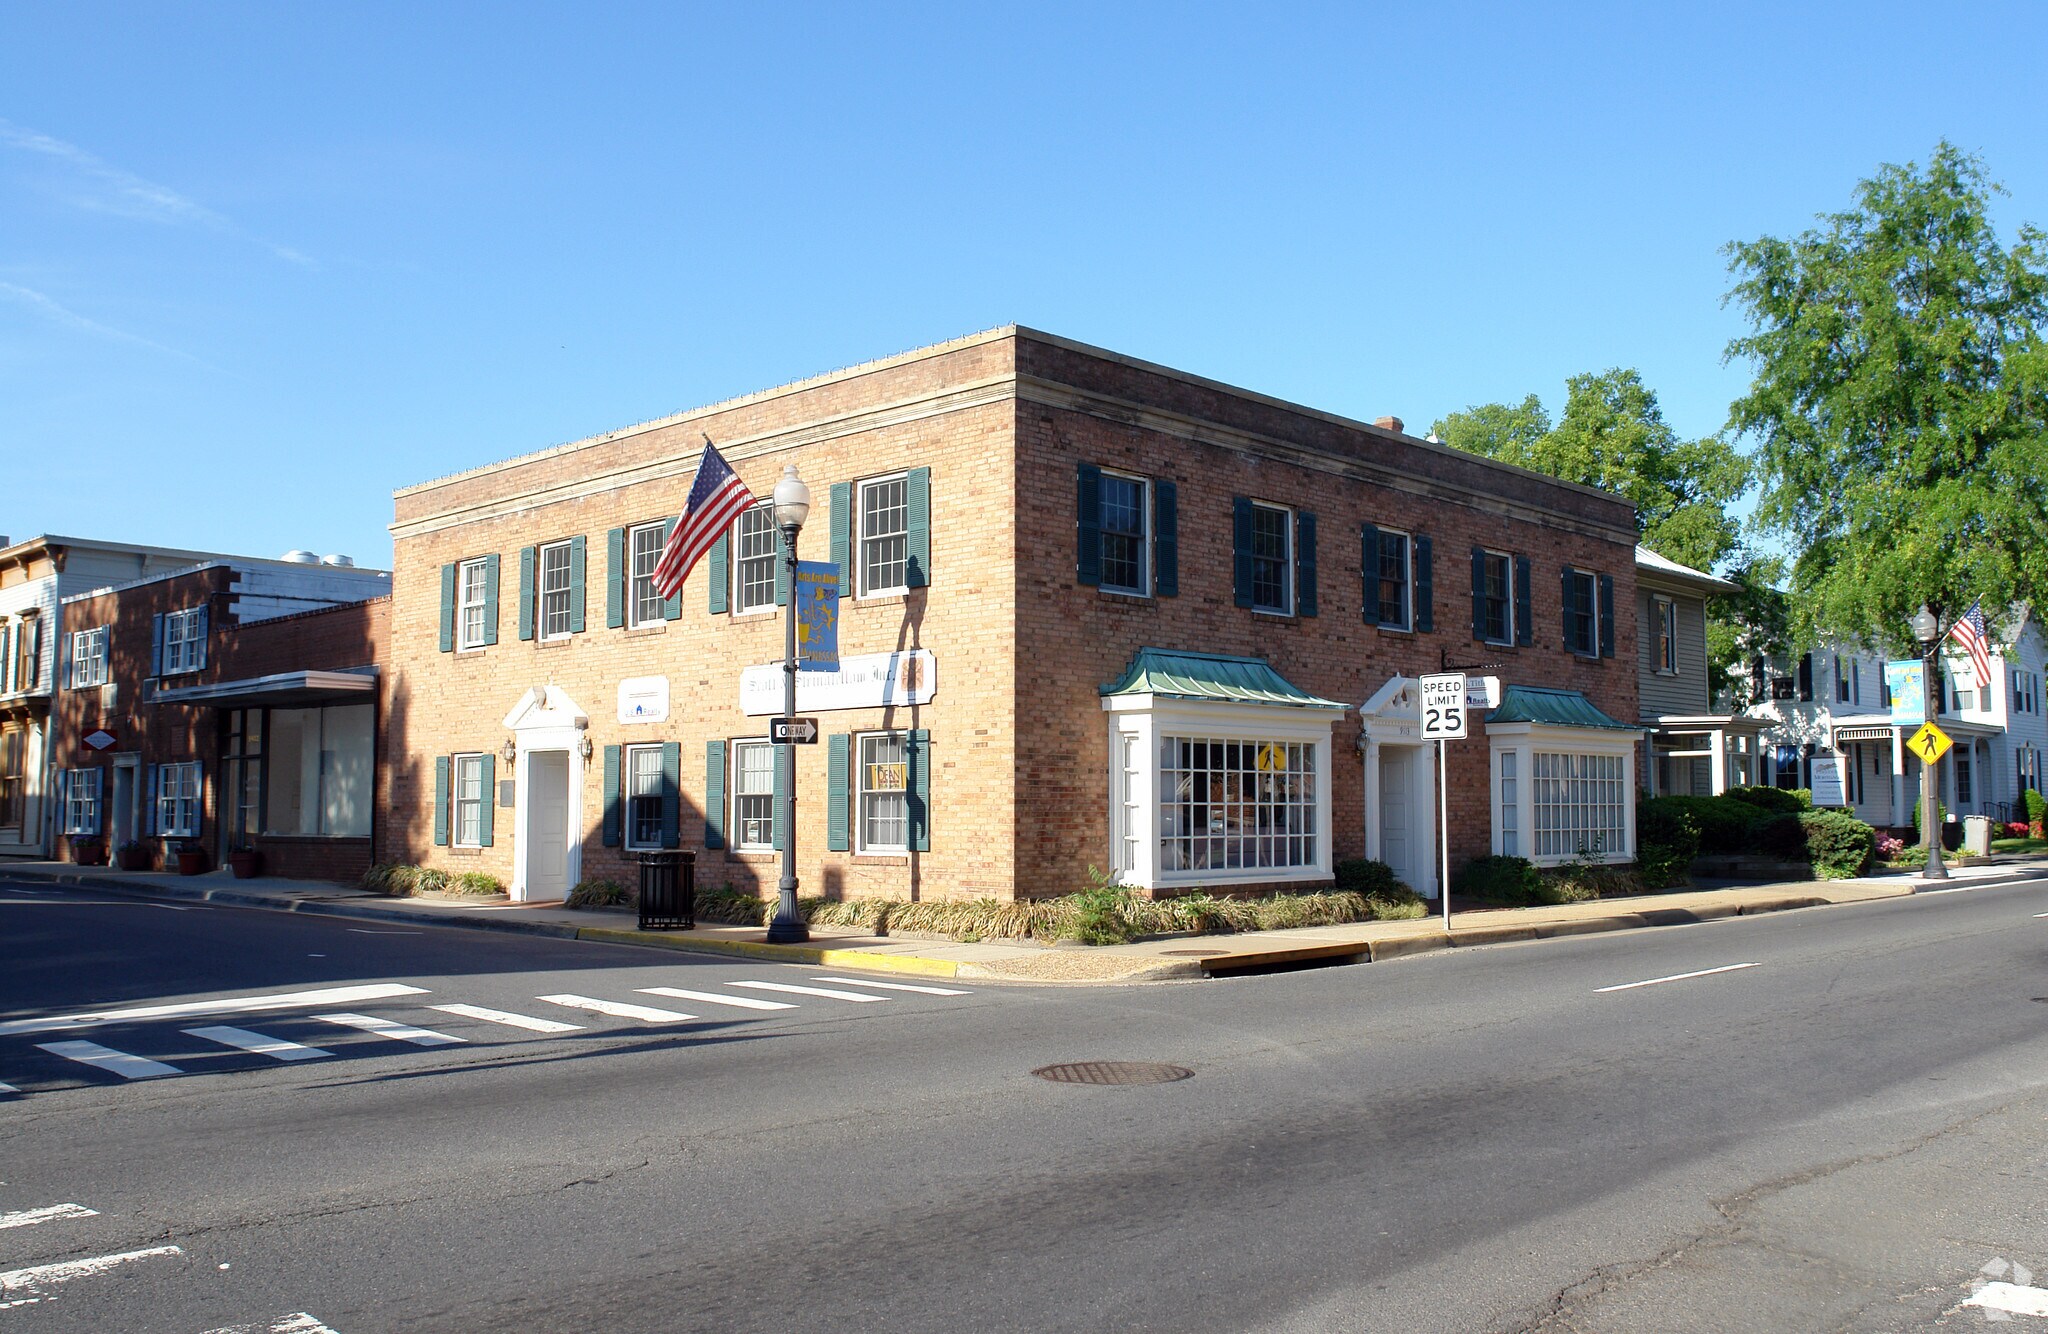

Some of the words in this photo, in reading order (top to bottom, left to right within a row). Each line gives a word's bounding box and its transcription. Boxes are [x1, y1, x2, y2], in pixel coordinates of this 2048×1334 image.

[1424, 682, 1461, 693] SPEED
[1428, 695, 1457, 706] LIMIT
[1426, 708, 1461, 731] 25
[780, 725, 794, 736] ONE
[794, 726, 806, 735] WAY
